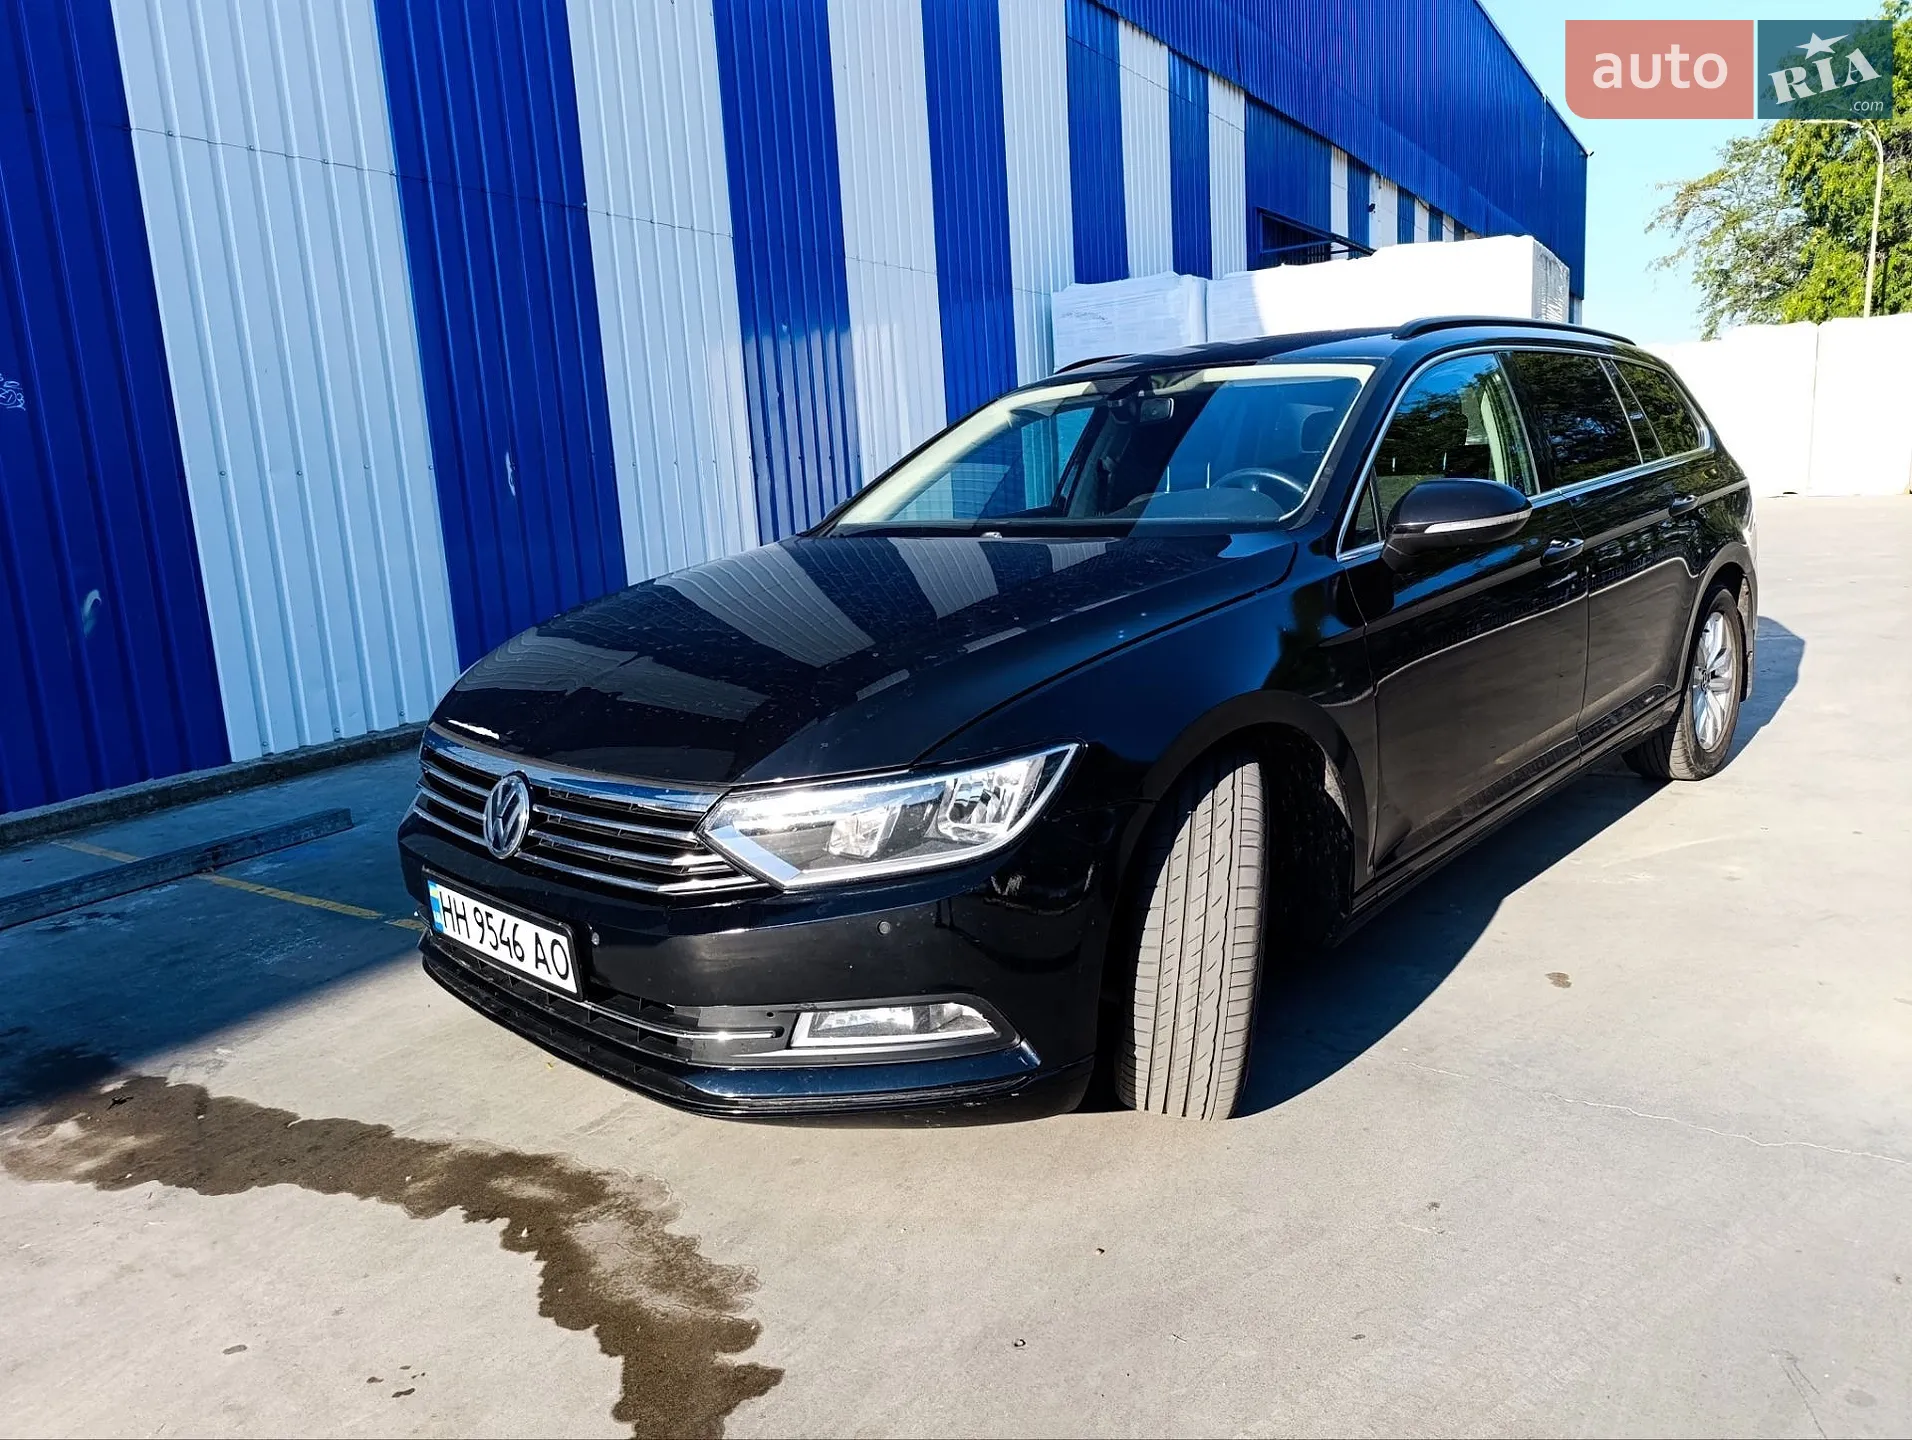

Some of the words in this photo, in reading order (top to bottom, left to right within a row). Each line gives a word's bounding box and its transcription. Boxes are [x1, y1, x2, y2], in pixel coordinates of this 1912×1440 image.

[439, 891, 470, 939] HH
[473, 906, 525, 963] 9546
[534, 931, 570, 981] AO
